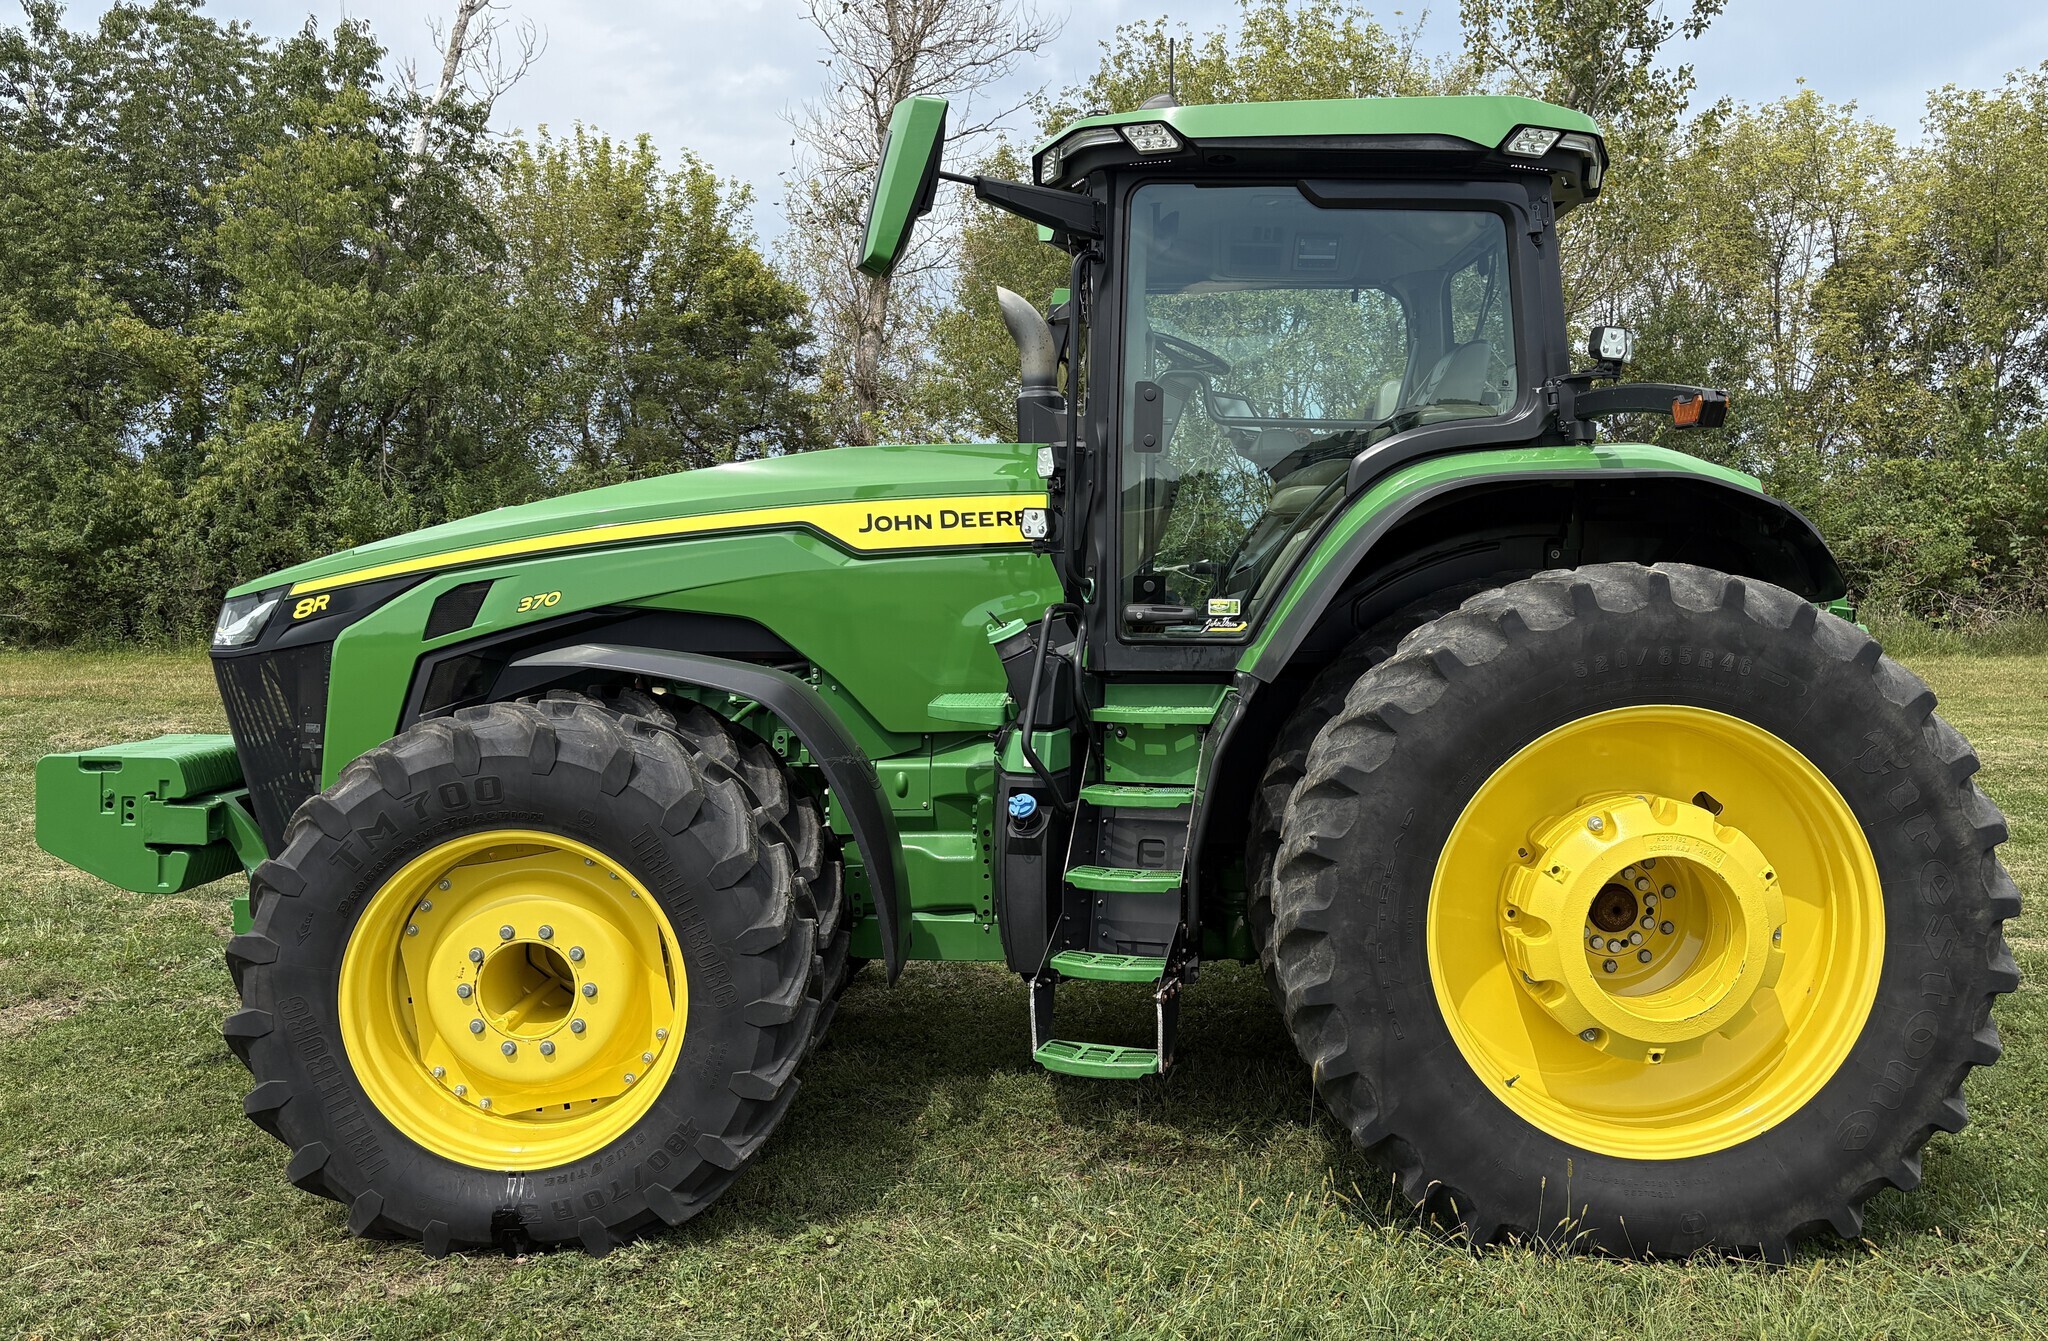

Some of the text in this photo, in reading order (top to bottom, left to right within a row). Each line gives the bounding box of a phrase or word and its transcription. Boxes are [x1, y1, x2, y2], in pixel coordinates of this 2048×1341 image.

[859, 513, 933, 533] JOHN
[292, 594, 330, 619] 8R
[516, 591, 562, 613] 370
[1574, 645, 1752, 678] 520/85R46
[630, 820, 738, 1008] TRELLEBORG
